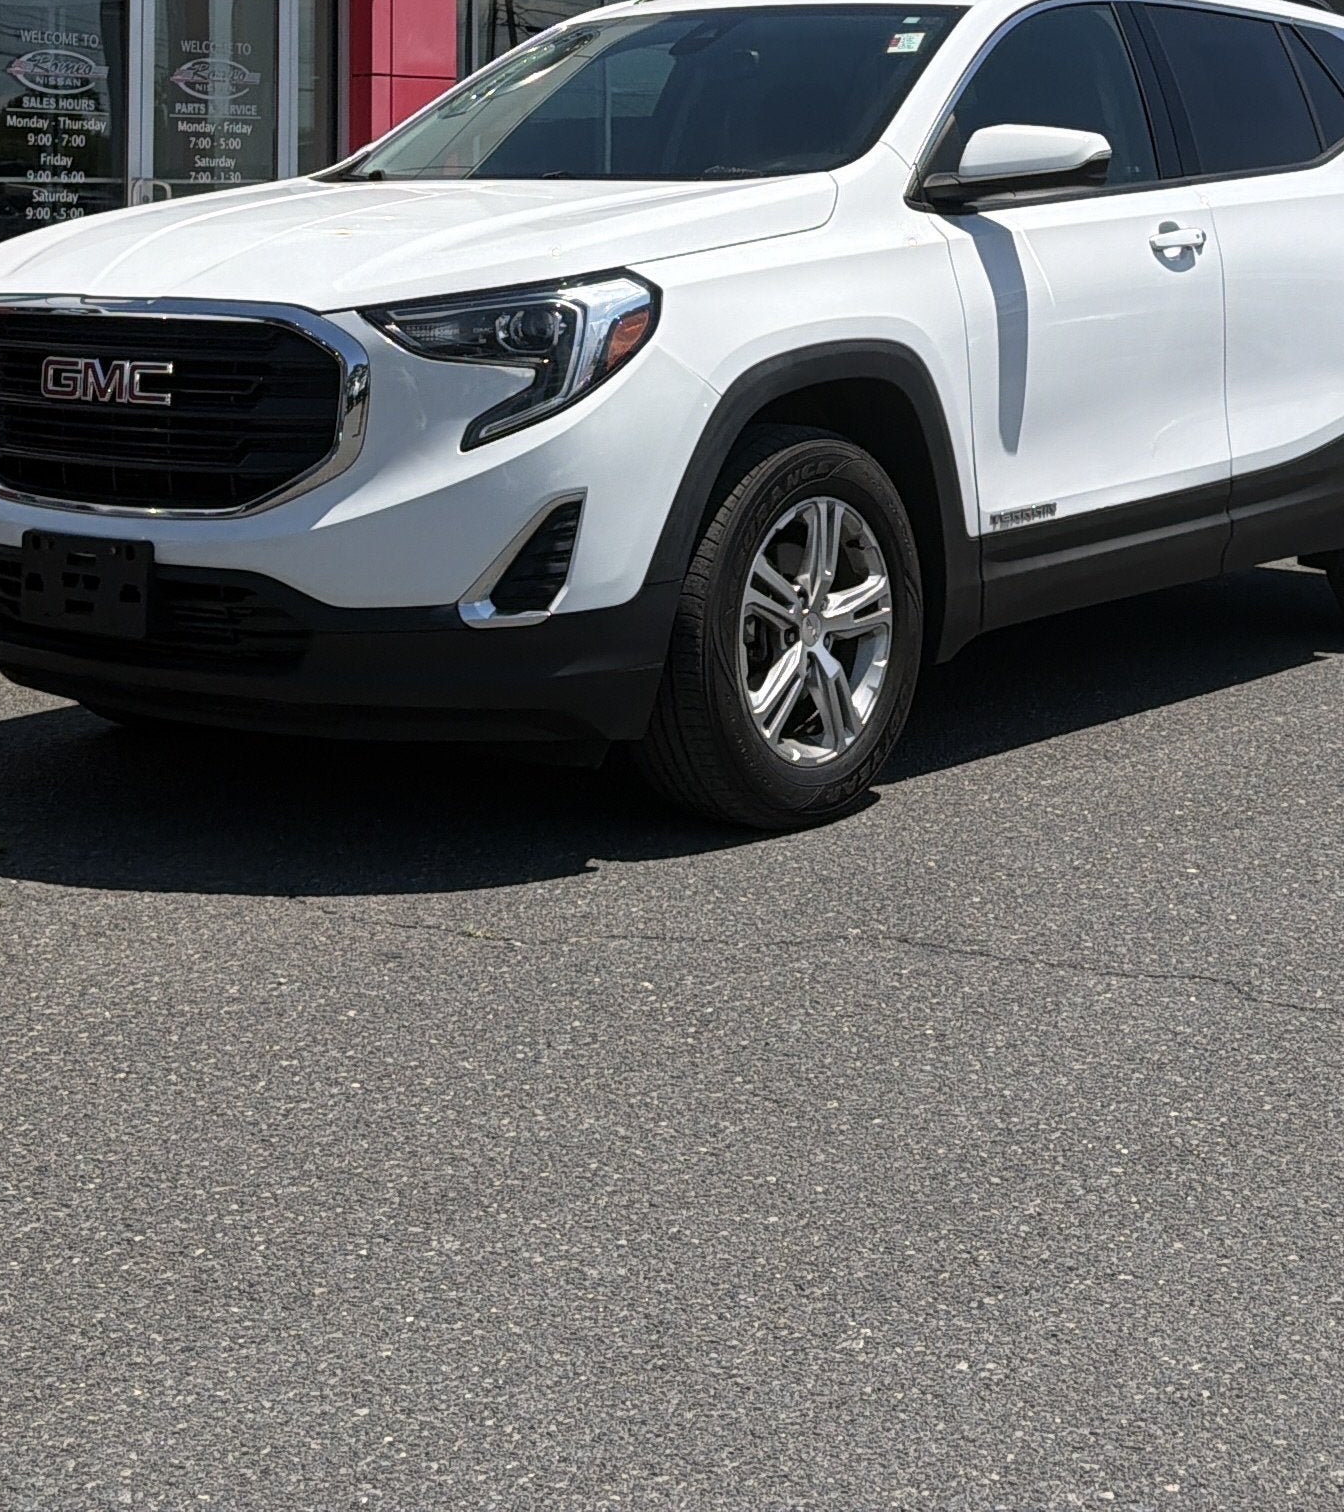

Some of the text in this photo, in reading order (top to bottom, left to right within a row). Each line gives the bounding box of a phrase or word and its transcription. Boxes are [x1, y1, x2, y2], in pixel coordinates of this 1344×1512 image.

[20, 29, 100, 48] WELCOME TO
[180, 39, 252, 56] WELCOE TO
[26, 50, 94, 76] Romeo
[35, 76, 82, 88] NISSAN
[195, 83, 236, 94] NISN
[22, 96, 96, 111] SALES HOURS
[175, 102, 206, 114] PARTS
[217, 104, 258, 116] RVICE
[6, 115, 49, 131] Monday
[58, 116, 107, 133] Thursday
[177, 120, 216, 135] Monday
[223, 121, 253, 137] Friday
[27, 133, 52, 146] 9:00
[61, 134, 86, 147] 7:00
[189, 137, 212, 149] 7:00
[219, 138, 242, 150] 5:00
[40, 153, 73, 168] Friday
[194, 155, 236, 170] Saturday
[26, 170, 51, 183] 9:00
[60, 171, 85, 183] 6:00
[189, 172, 212, 184] 7:00
[220, 172, 242, 184] 1:30
[32, 189, 79, 205] Saturday
[25, 207, 51, 220] 9:00
[41, 356, 173, 406] GMC
